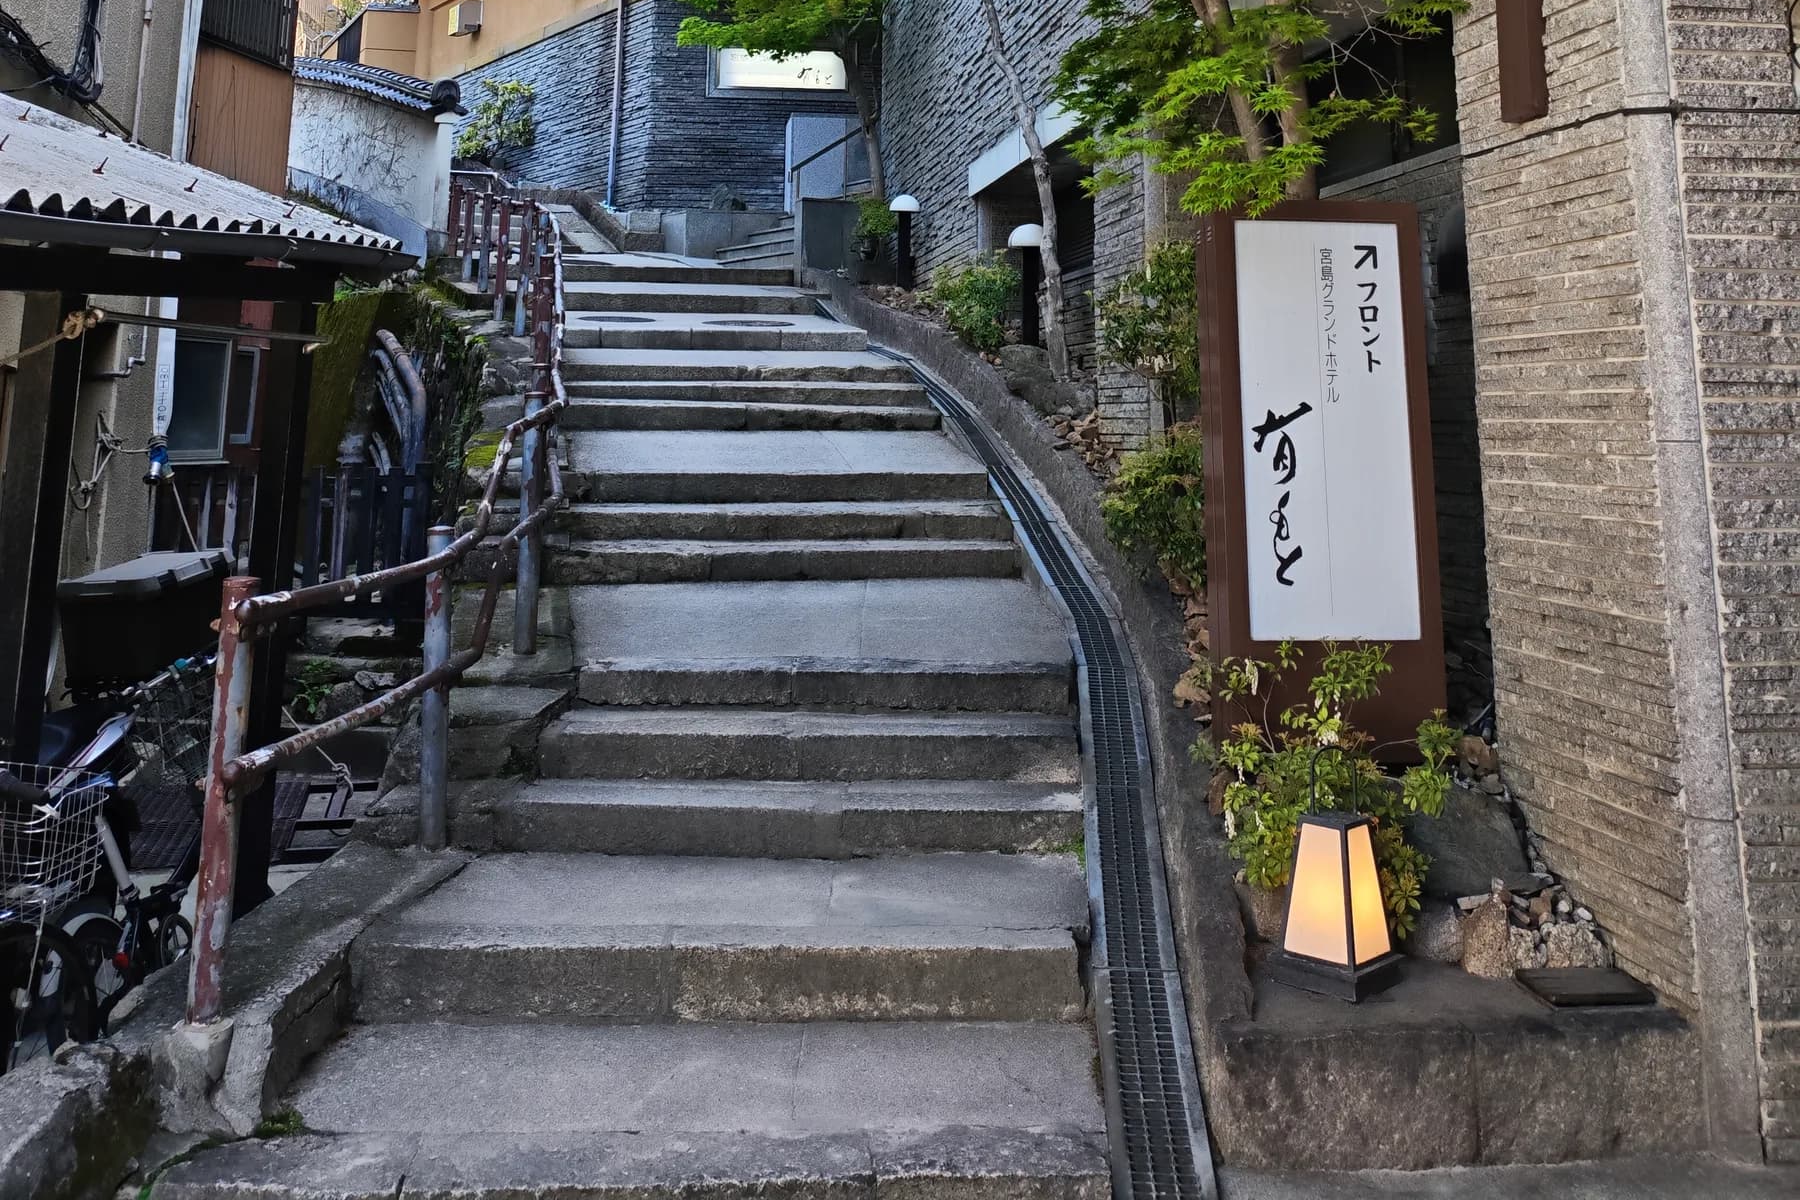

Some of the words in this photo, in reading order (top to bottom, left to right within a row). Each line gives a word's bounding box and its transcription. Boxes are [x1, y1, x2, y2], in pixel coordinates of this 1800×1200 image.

[1319, 247, 1340, 404] 宮島グランドホテル
[1356, 281, 1382, 373] フロント
[1251, 402, 1313, 586] 有もと
